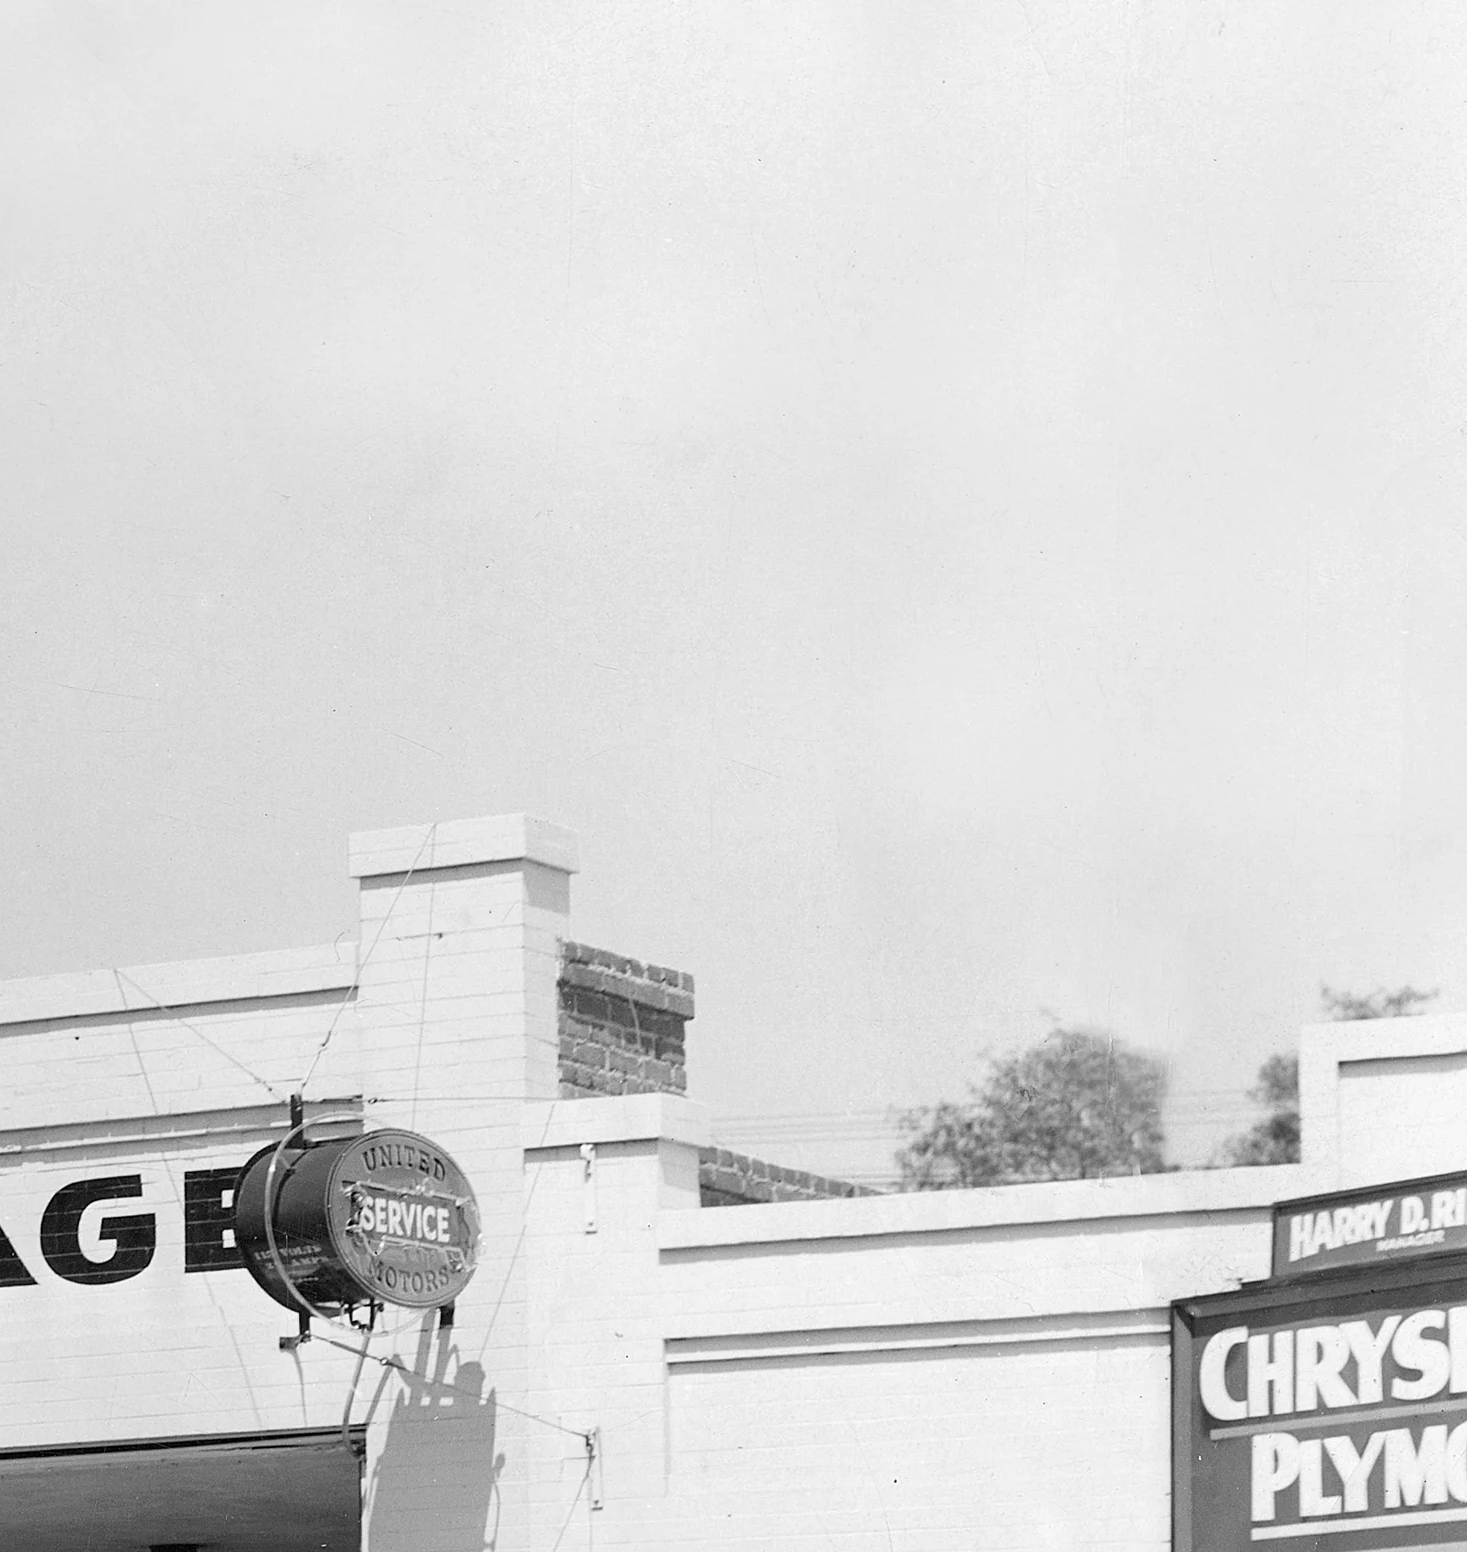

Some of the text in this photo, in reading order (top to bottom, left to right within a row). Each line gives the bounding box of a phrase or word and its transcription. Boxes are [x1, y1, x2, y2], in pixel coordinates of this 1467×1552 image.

[361, 1144, 446, 1182] UNITED
[360, 1195, 451, 1243] SERVICE
[1288, 1200, 1395, 1263] HARRY
[1399, 1196, 1430, 1235] D.
[367, 1260, 450, 1295] MOTORS
